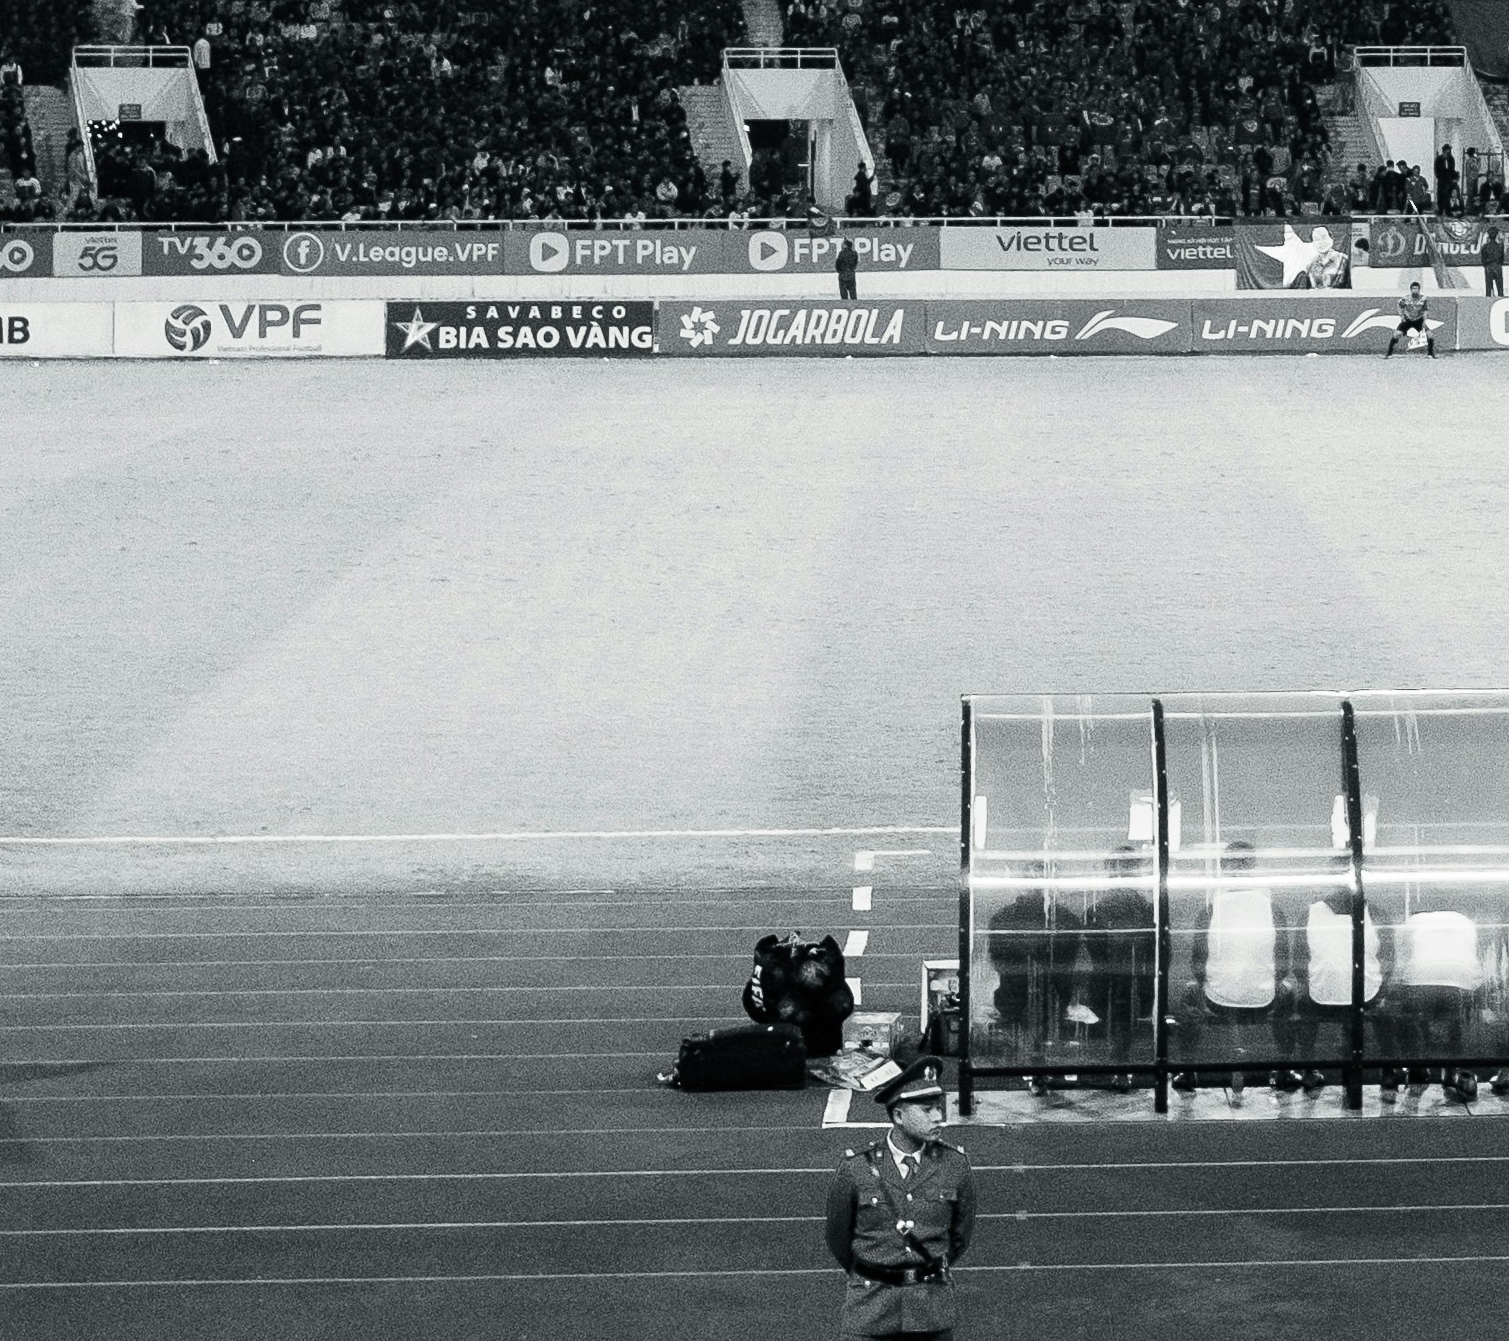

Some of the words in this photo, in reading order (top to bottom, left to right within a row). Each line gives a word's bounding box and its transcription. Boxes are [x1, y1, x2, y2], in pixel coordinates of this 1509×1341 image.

[157, 235, 262, 269] TV360
[575, 239, 630, 265] FPT
[636, 238, 697, 270] Play
[855, 237, 914, 268] Play
[996, 231, 1099, 253] viettel
[78, 245, 120, 271] 5G
[217, 303, 323, 339] VPF
[466, 305, 627, 320] SAVABECO
[728, 308, 904, 345] JOGARBOLA
[439, 326, 493, 349] BIA
[497, 325, 560, 350] SAO
[564, 320, 653, 350] VÀNG
[934, 320, 1069, 341] LI-NING
[1202, 318, 1336, 339] LI-NING
